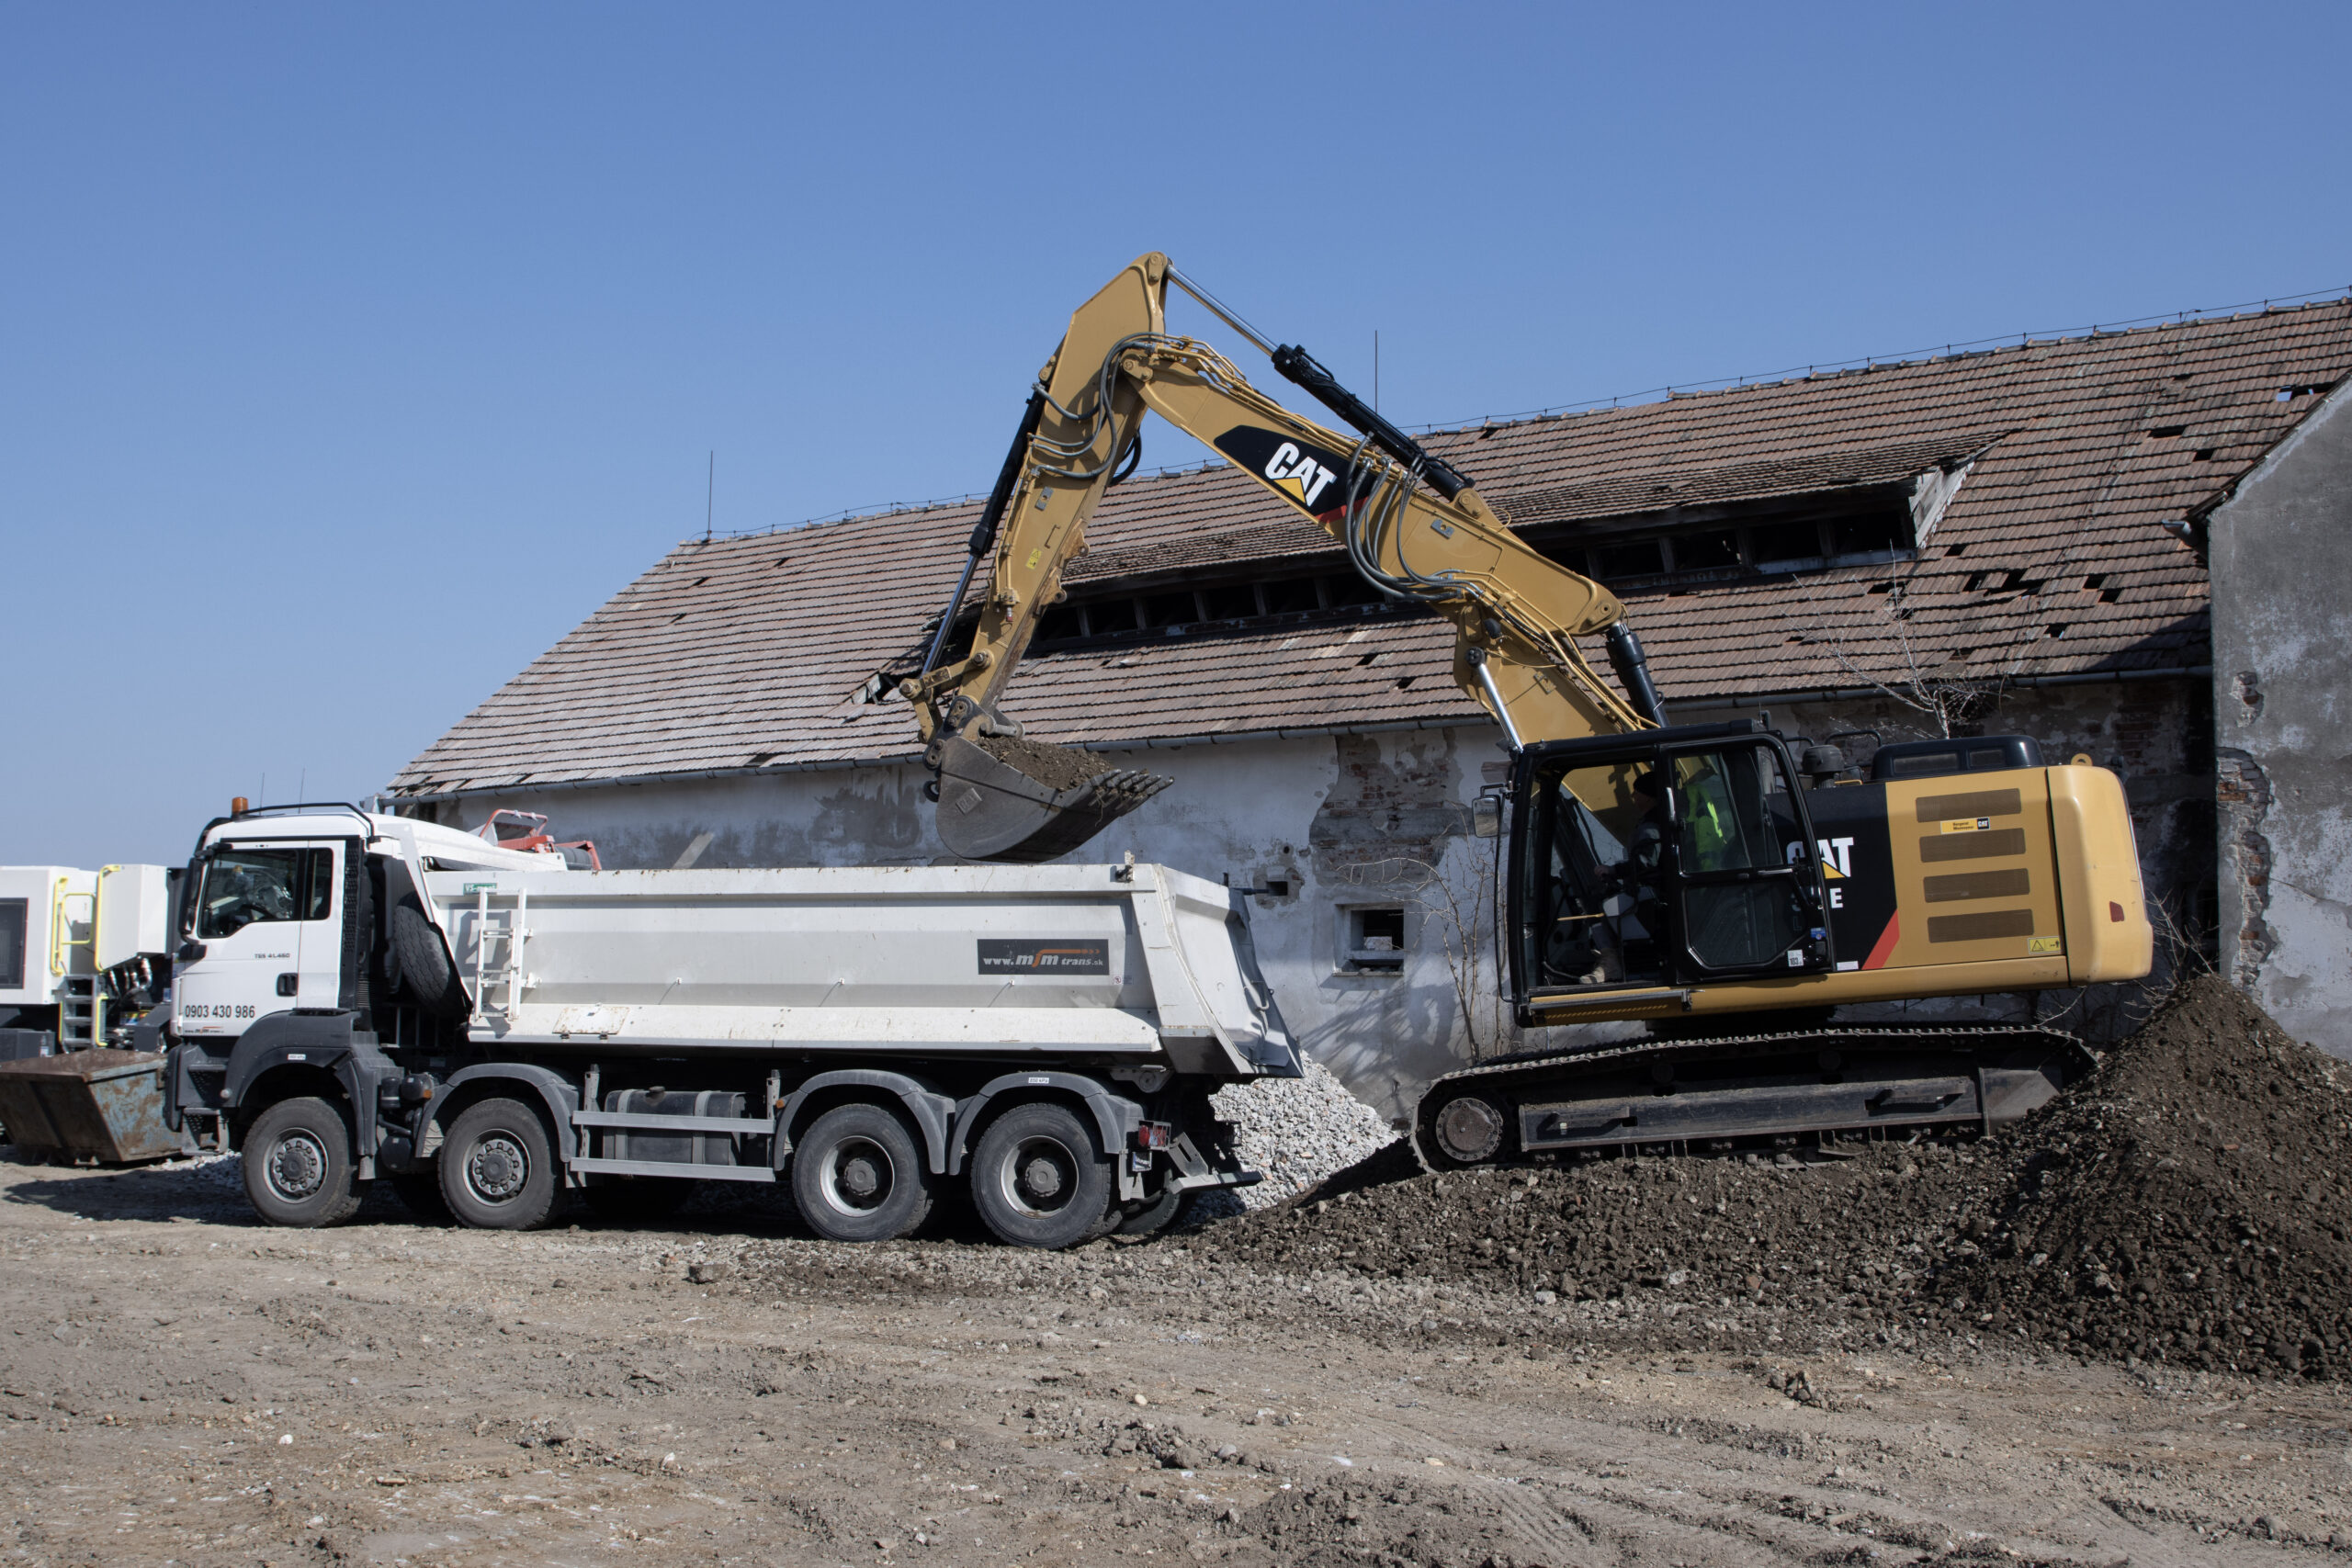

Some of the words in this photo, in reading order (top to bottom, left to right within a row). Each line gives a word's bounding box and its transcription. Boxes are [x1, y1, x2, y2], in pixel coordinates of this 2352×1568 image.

[1265, 442, 1338, 507] CAT
[1061, 956, 1103, 966] trans.sk
[185, 1004, 209, 1018] 0903
[212, 1005, 232, 1018] 430
[235, 1005, 255, 1019] 986
